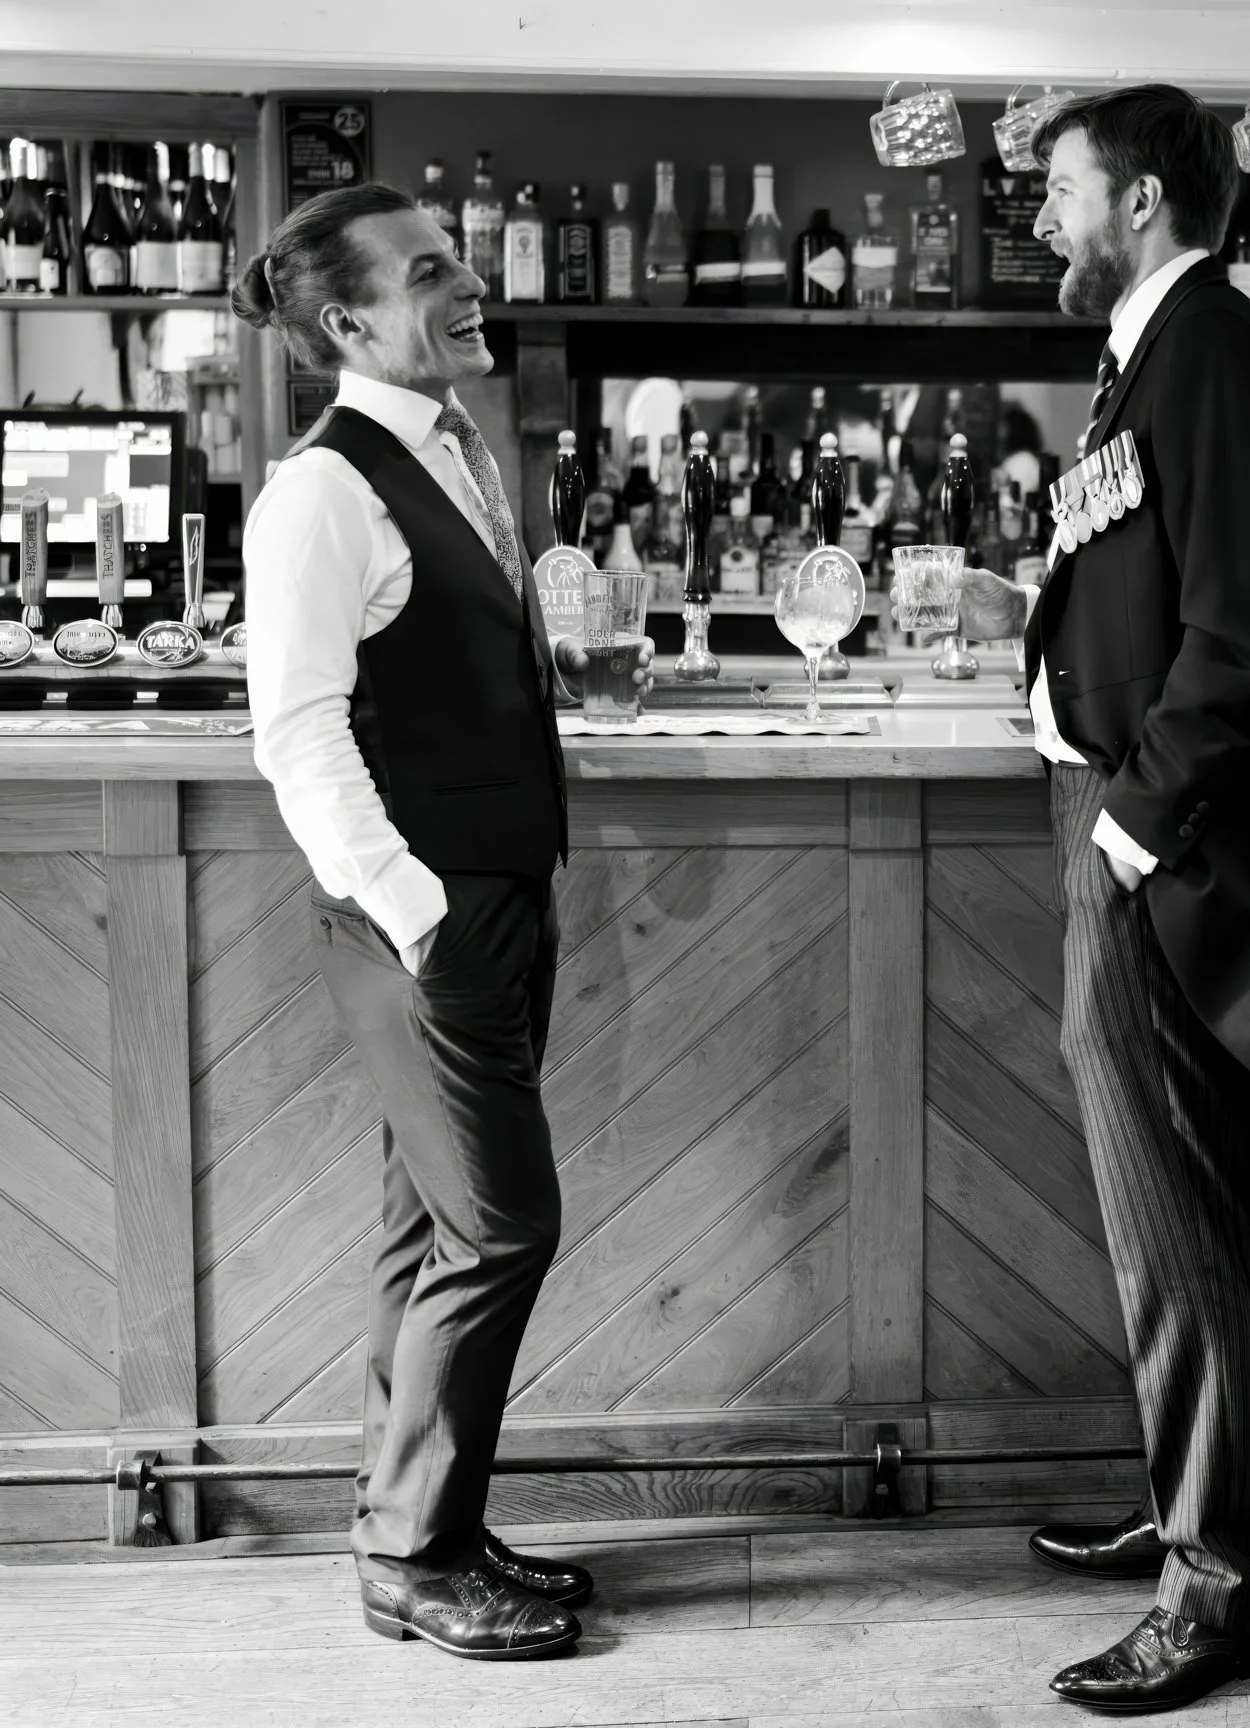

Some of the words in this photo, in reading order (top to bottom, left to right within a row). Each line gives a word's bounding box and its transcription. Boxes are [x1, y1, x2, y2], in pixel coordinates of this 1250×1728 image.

[338, 112, 361, 131] 25
[538, 589, 583, 605] OTTE
[145, 631, 196, 650] TARKA
[588, 629, 616, 639] CIDER
[588, 638, 616, 647] DONE
